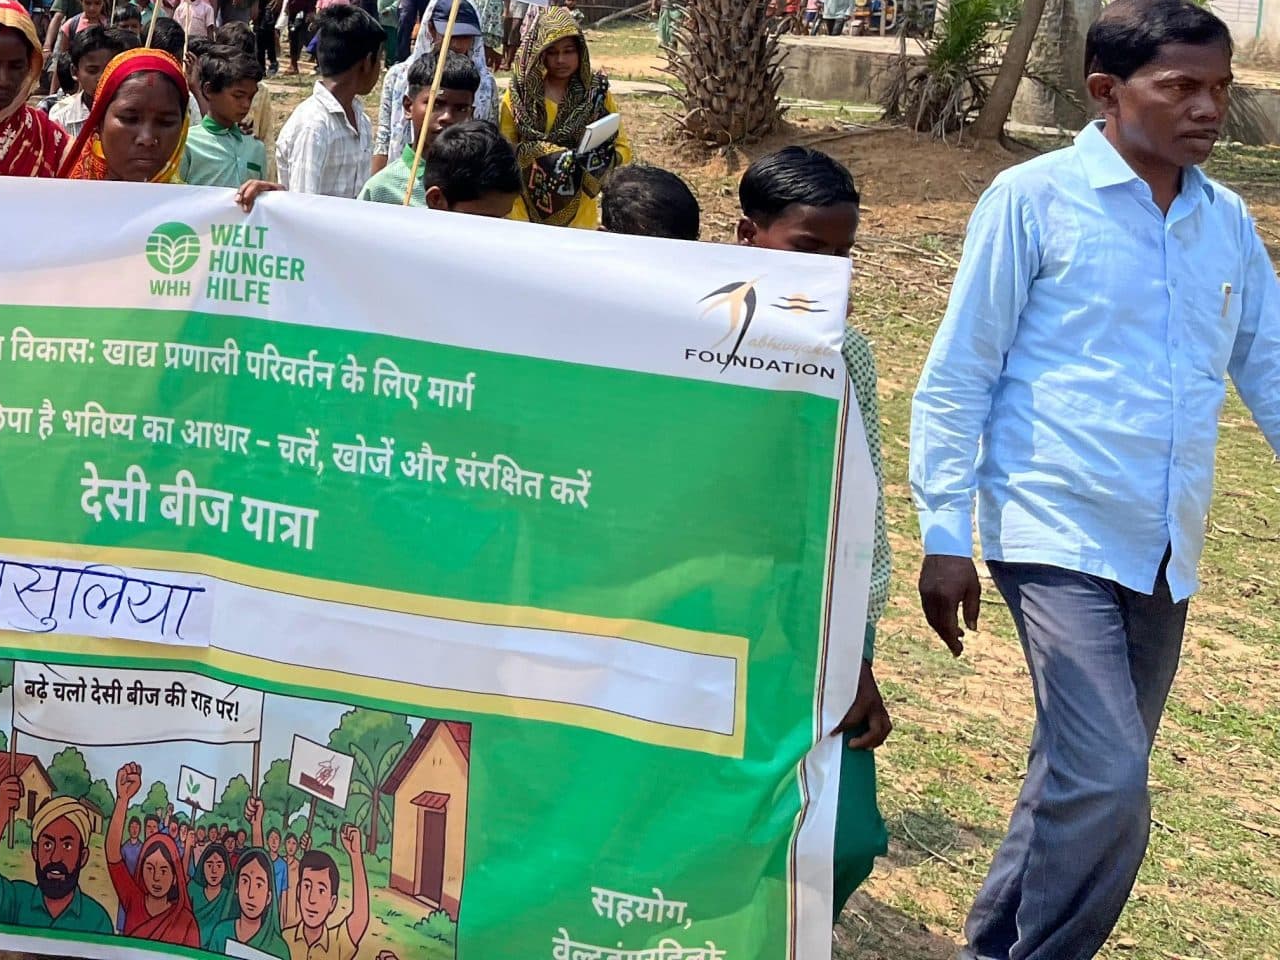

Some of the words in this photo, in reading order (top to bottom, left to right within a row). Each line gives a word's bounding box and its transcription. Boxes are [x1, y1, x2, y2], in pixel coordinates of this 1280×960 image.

[210, 224, 269, 249] WELT
[208, 250, 305, 281] HUNGER
[150, 279, 191, 296] WHH
[206, 276, 270, 305] HILFE
[11, 326, 95, 364] विकास:
[102, 339, 158, 368] खाद्य
[164, 338, 240, 375] प्रणाली
[246, 343, 335, 390] परिवर्तन
[341, 353, 367, 393] के
[373, 357, 422, 409] लिए
[427, 372, 476, 411] मार्ग
[685, 348, 835, 380] FOUNDATION
[38, 399, 56, 440] है
[63, 401, 136, 440] भविष्य
[142, 415, 174, 444] का
[180, 417, 251, 455] आधार
[277, 427, 324, 476] चलें,
[332, 434, 395, 478] खोजें
[400, 442, 449, 483] और
[455, 451, 544, 499] संरक्षित
[550, 469, 592, 508] करें
[80, 462, 151, 523] देसी
[160, 469, 233, 534] बीज
[241, 494, 319, 550] यात्रा
[53, 676, 87, 704] चलो
[91, 677, 122, 705] देसी
[126, 679, 159, 708] बीज
[165, 682, 186, 708] की
[191, 688, 212, 718] राह
[216, 697, 239, 723] पर!
[591, 886, 692, 930] सहयोग,
